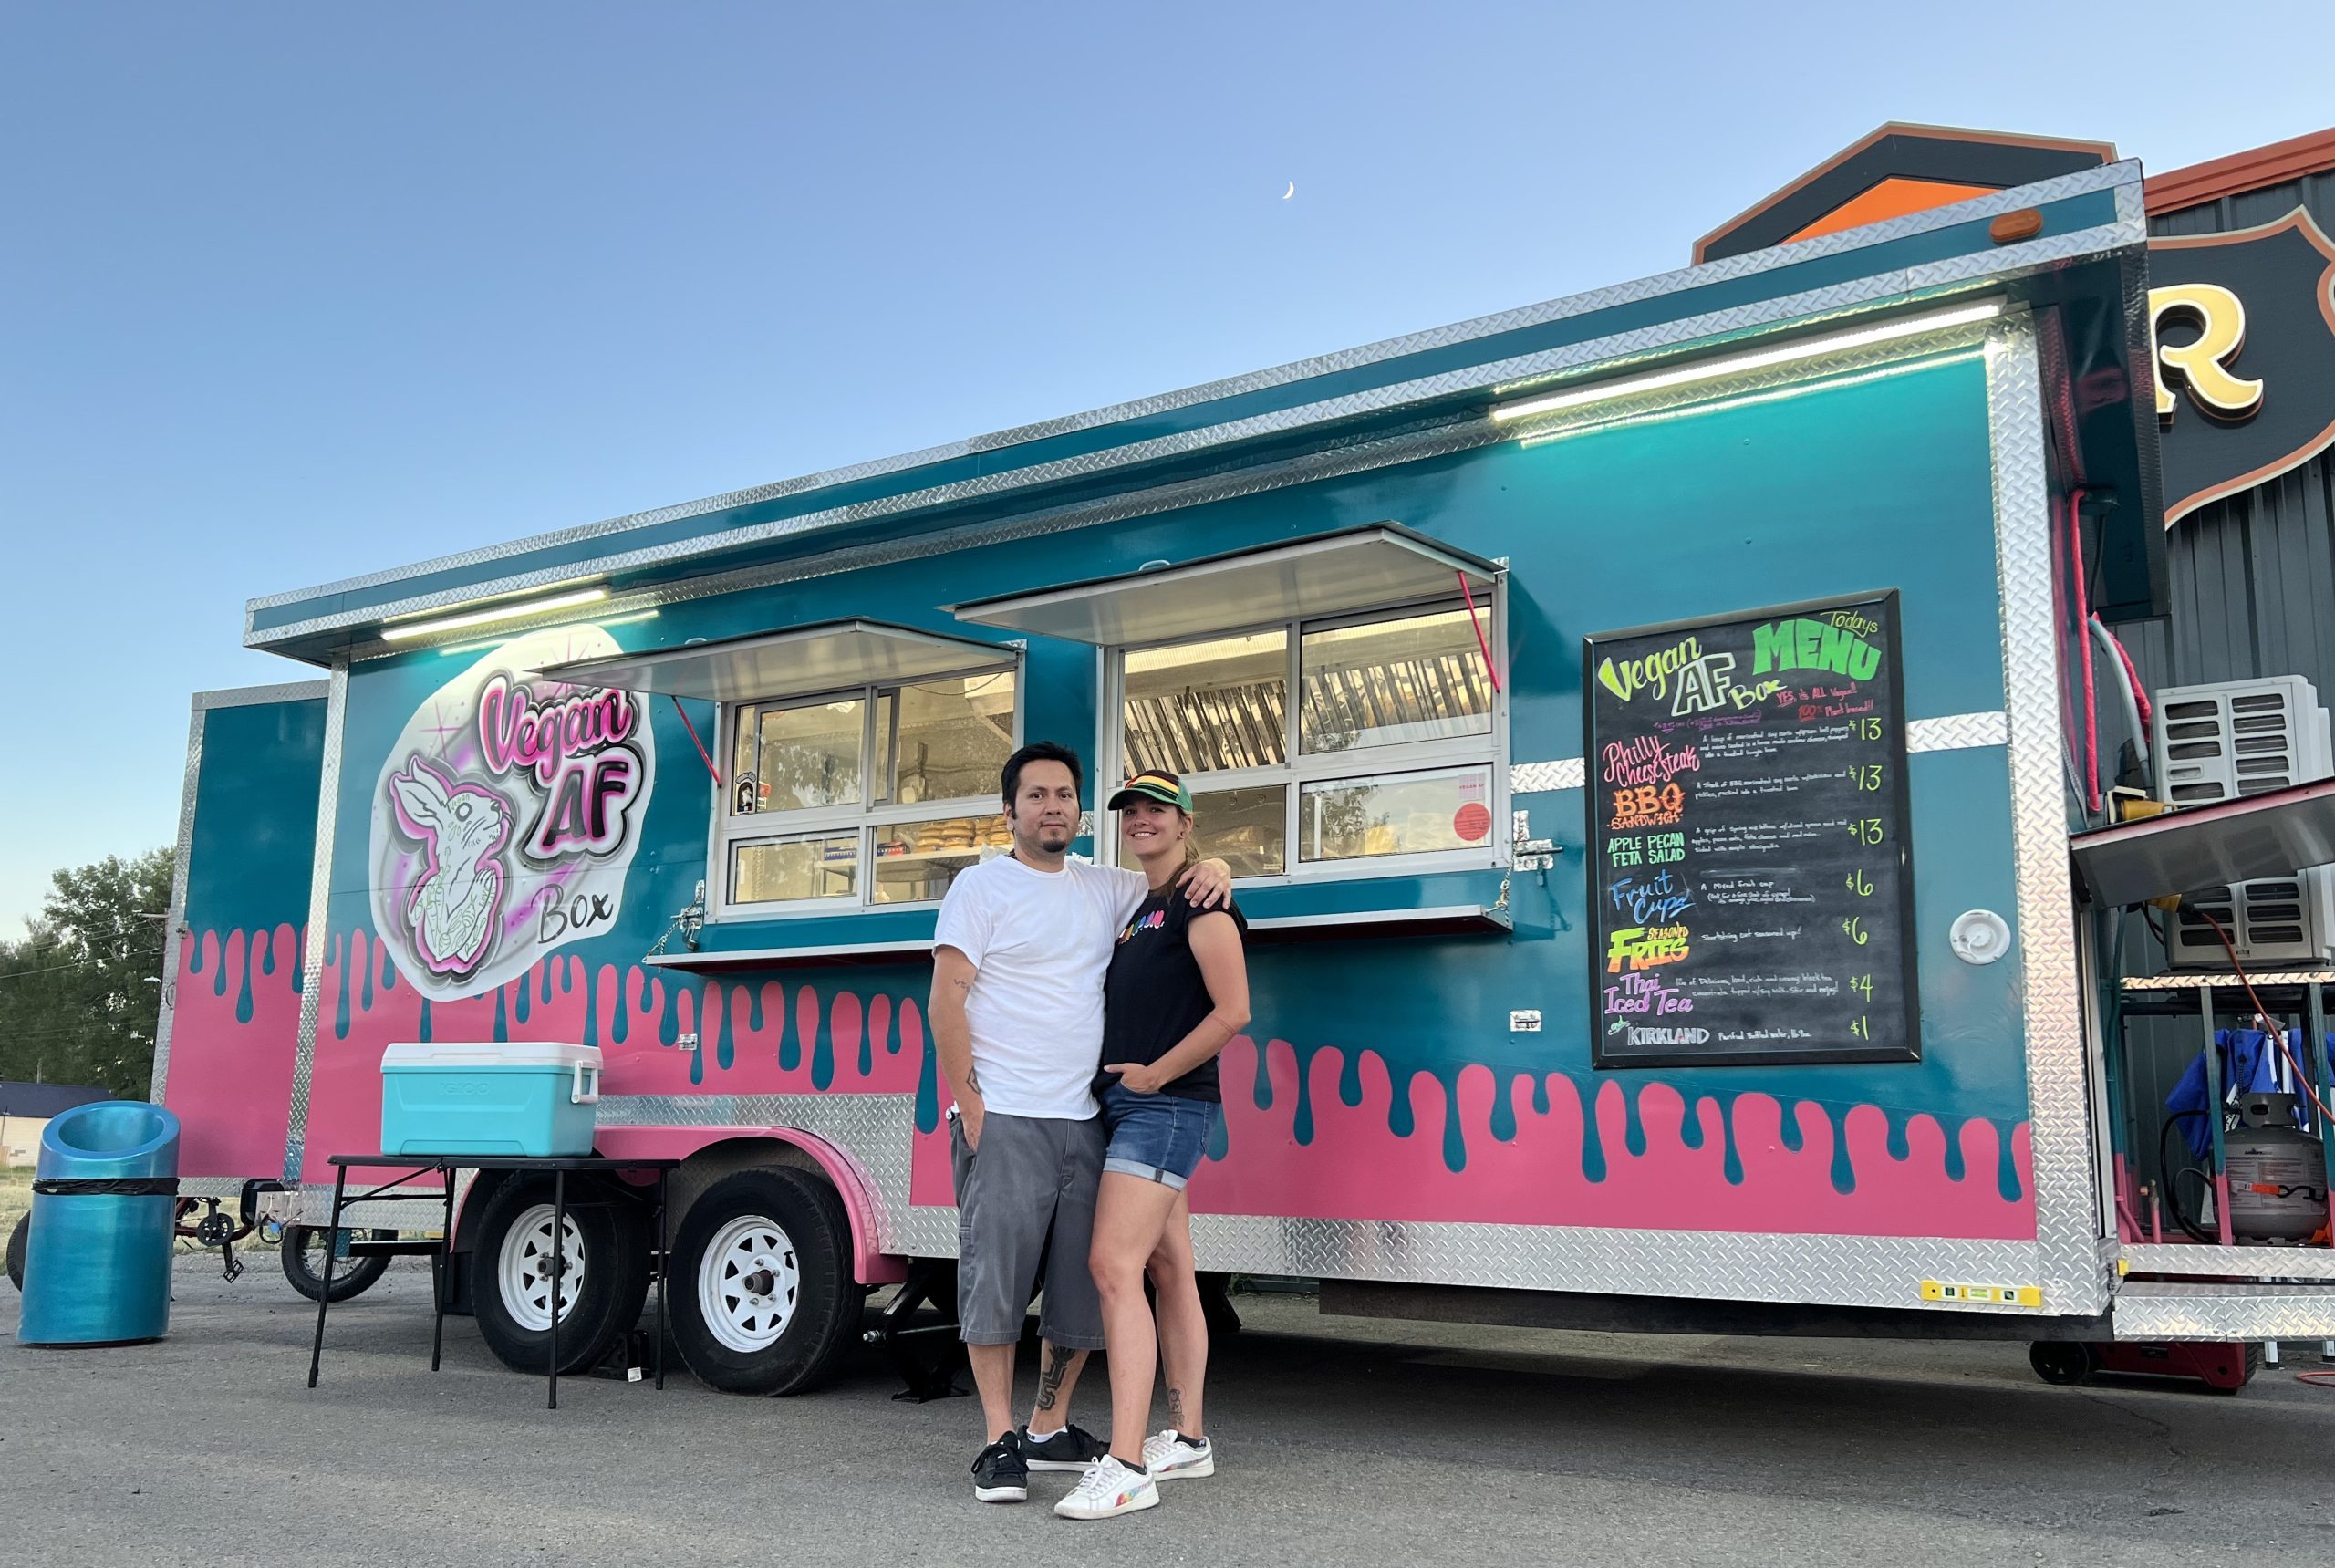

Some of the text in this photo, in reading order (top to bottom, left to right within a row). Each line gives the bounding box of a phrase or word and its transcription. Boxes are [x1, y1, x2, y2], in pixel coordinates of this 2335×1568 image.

[2147, 283, 2264, 418] R
[1820, 611, 1879, 639] Todays
[1753, 618, 1882, 682] MENU
[1598, 636, 1702, 701] Vegan
[1671, 651, 1736, 717] AF
[1728, 679, 1788, 710] Box
[1812, 687, 1826, 699] ALL
[479, 675, 632, 779] Vegan
[1848, 717, 1883, 741] $13
[1603, 735, 1671, 781] Philly
[1848, 764, 1883, 792] $13
[539, 759, 631, 850] AF
[1613, 783, 1686, 818] BBQ
[1607, 832, 1685, 853] APPLE PECAN
[1848, 819, 1884, 846] $13
[1613, 847, 1686, 867] FETA SALAD
[1610, 868, 1673, 910] Fruit
[1846, 868, 1873, 898] $6
[531, 883, 613, 945] Box
[1634, 888, 1697, 925] Cups
[1647, 922, 1689, 940] SEASONED
[1842, 916, 1868, 945] $6
[1607, 927, 1690, 972] FRIES
[1620, 972, 1661, 996] Thai
[1850, 974, 1873, 1002] $4
[1604, 987, 1693, 1016] Iced Tea
[1627, 1025, 1711, 1045] KIRKLAND
[1850, 1016, 1870, 1040] $1
[441, 1082, 491, 1096] IGLOO
